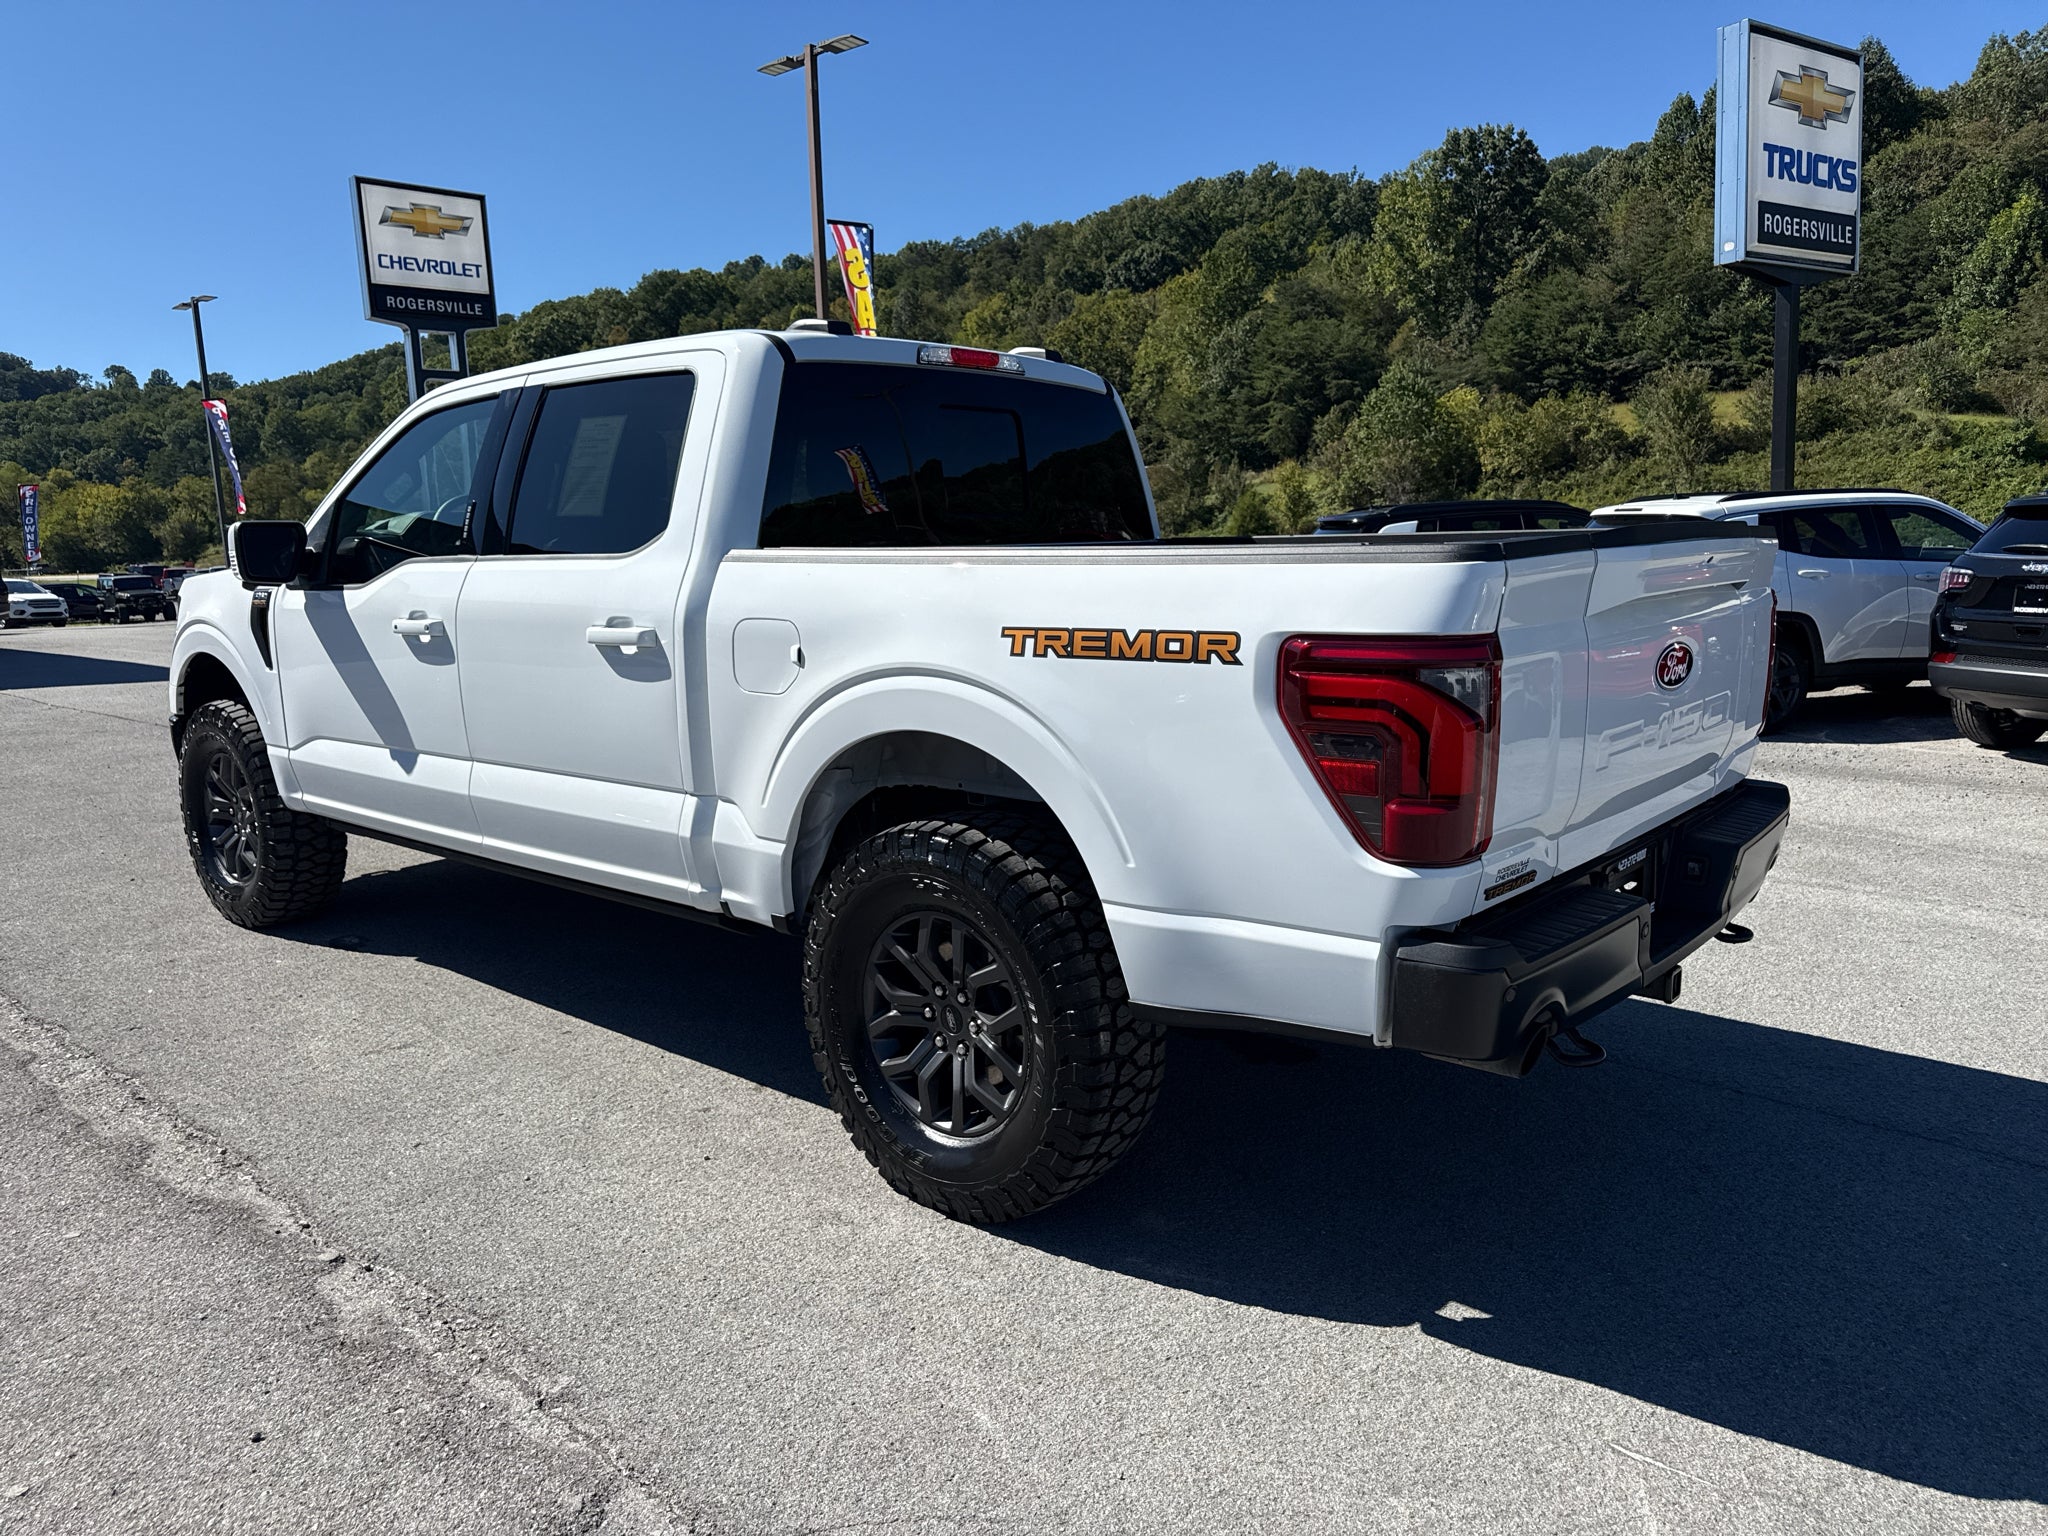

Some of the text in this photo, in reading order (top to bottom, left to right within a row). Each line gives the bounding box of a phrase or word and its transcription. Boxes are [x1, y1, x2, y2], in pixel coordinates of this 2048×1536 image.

[1763, 142, 1857, 193] TRUCKS
[1764, 213, 1853, 244] ROGERSVILLE
[377, 253, 482, 278] CHEVROLET
[386, 295, 483, 316] ROGERSVILLE
[24, 516, 36, 558] OWNED
[1001, 626, 1244, 666] TREMOR
[1663, 650, 1690, 682] Ford
[1596, 690, 1732, 772] F-150
[1485, 871, 1537, 900] TREMOR
[1495, 864, 1529, 884] CHEVROLET
